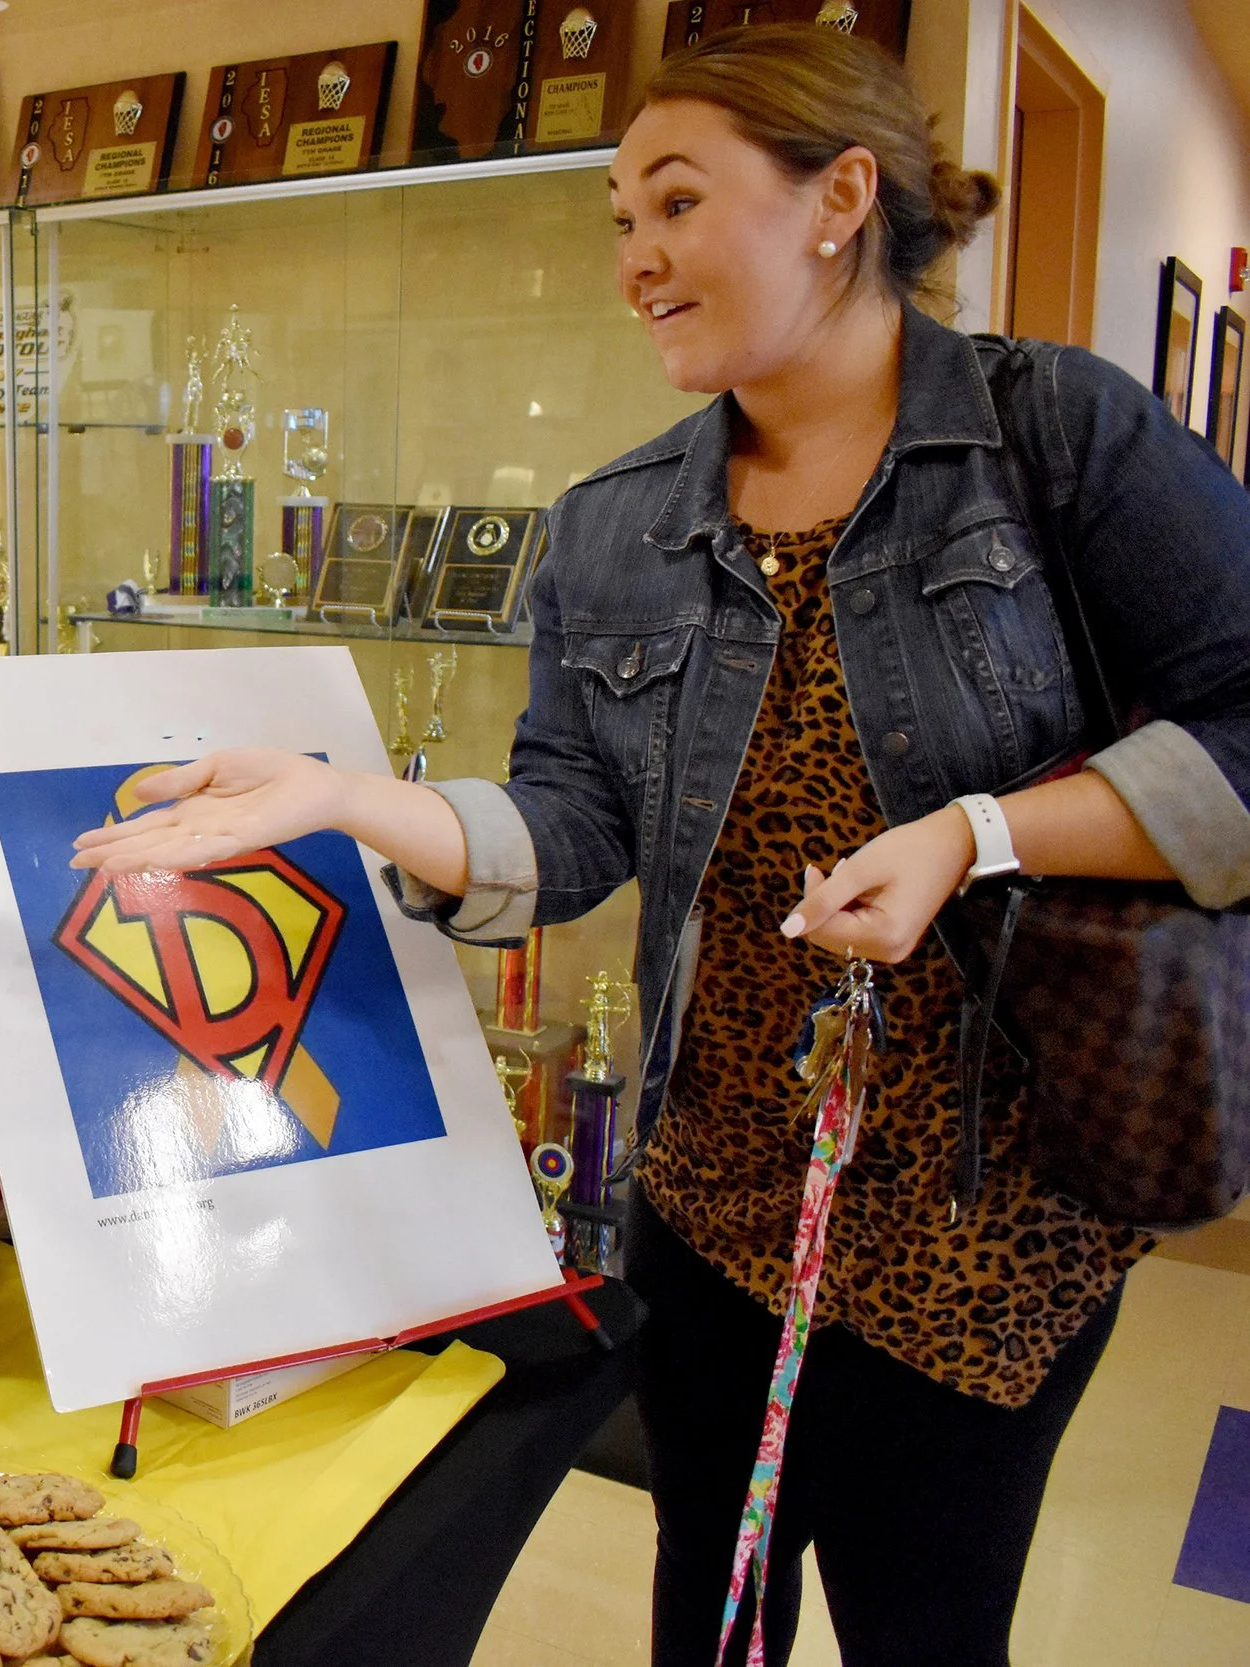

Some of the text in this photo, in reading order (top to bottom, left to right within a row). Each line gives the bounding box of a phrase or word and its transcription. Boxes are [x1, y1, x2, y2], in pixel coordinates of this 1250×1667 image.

[450, 25, 509, 54] 2016
[547, 78, 599, 95] CHAMPIONS
[258, 71, 271, 138] IESA
[62, 101, 75, 163] IESA
[301, 122, 352, 137] REGIONAL
[295, 132, 354, 148] CHAMPIONS
[99, 148, 144, 162] REGIONAL
[94, 159, 147, 172] CHAMPIONS
[234, 1403, 251, 1419] BWK
